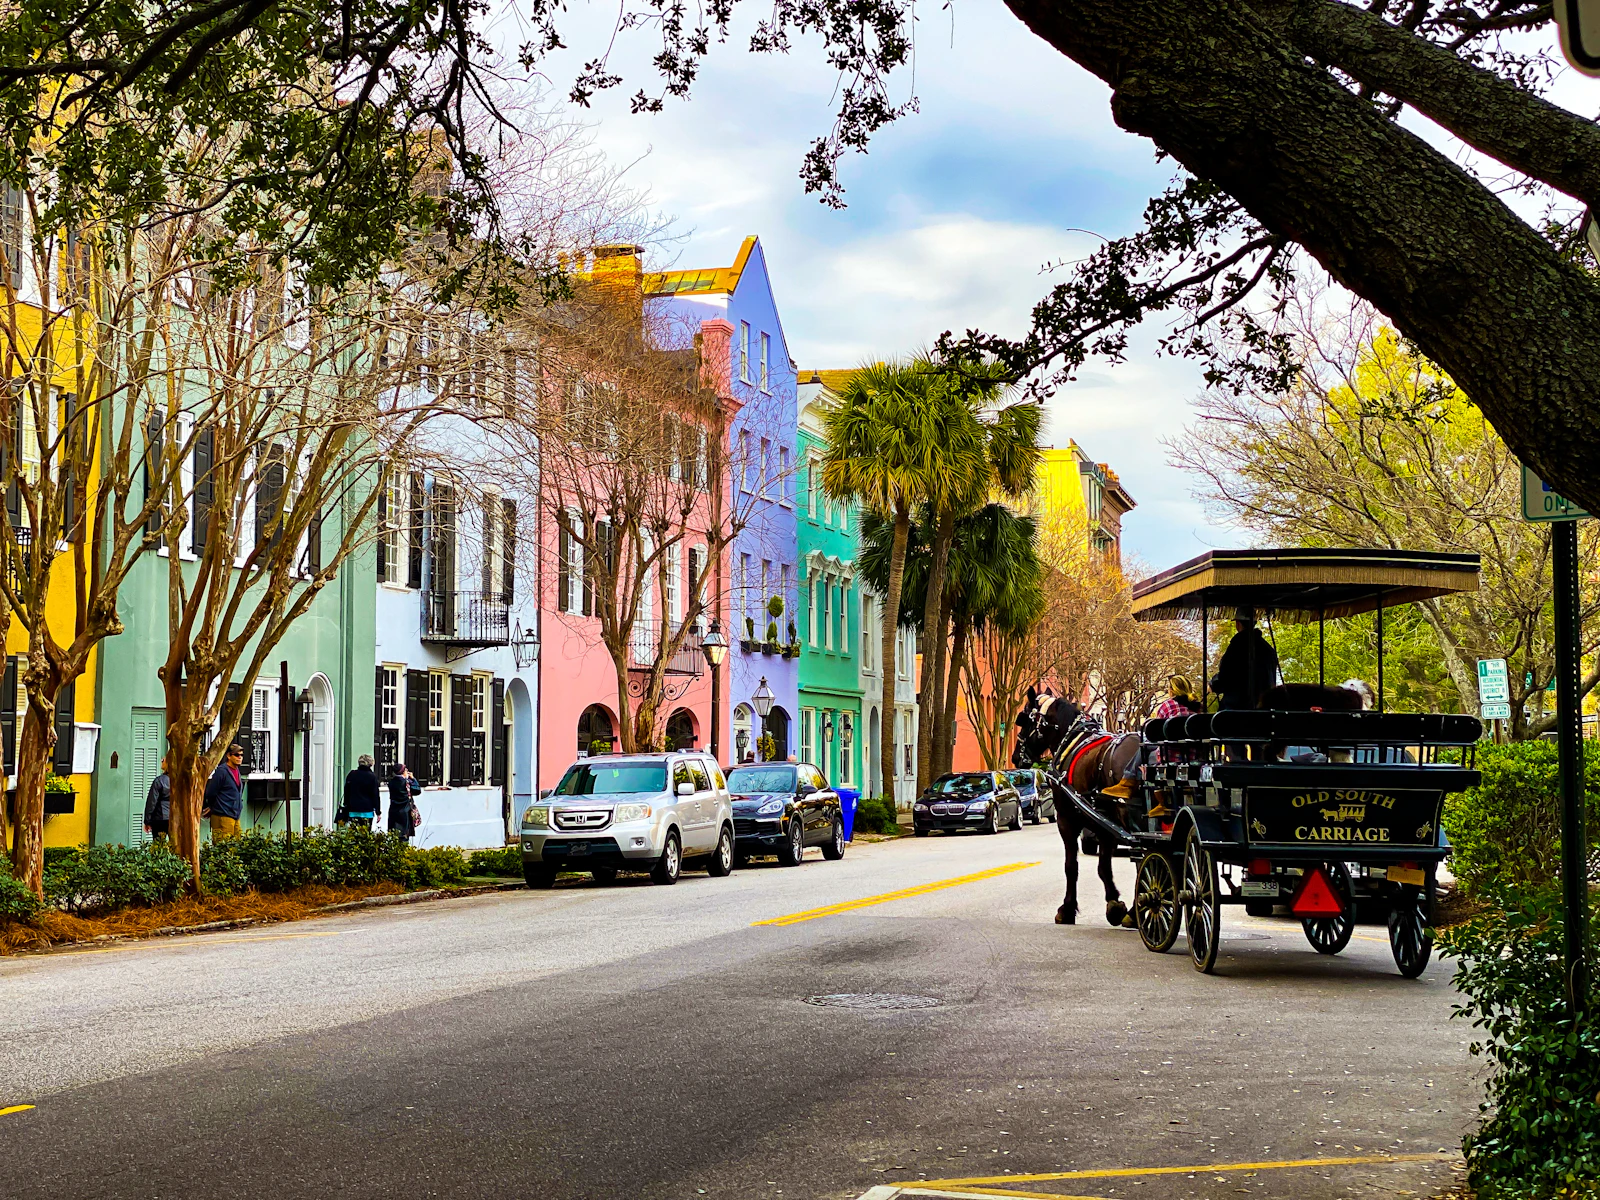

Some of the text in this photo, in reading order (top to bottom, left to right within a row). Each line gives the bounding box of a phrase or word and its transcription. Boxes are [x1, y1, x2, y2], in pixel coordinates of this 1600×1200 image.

[1544, 495, 1580, 512] ONL
[1291, 789, 1397, 810] OLD SOUTH
[1294, 826, 1390, 842] CARRIAGE
[1261, 880, 1278, 890] 338
